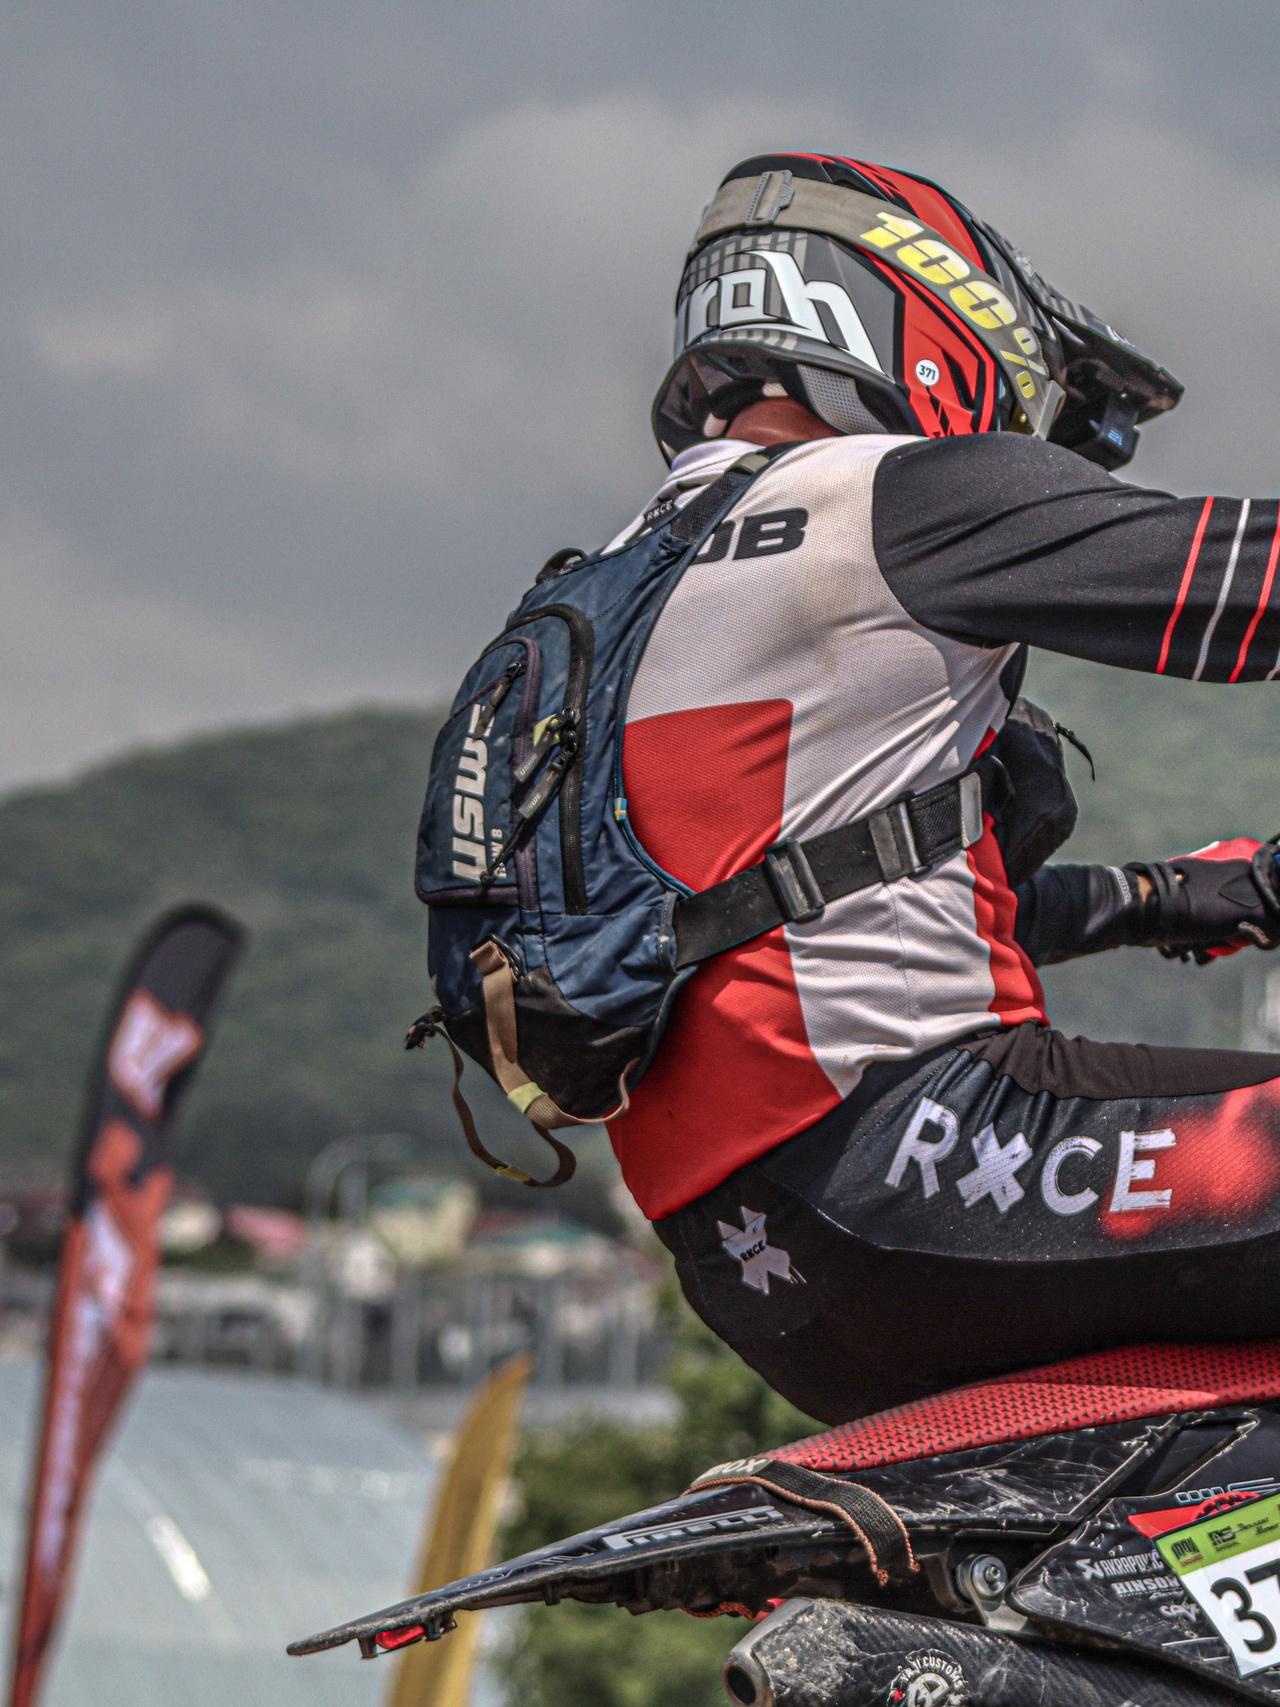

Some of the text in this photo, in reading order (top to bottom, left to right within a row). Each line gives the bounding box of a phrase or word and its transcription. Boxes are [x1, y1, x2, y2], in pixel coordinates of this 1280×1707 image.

[678, 249, 886, 376] roh
[861, 211, 1048, 399] 100%
[919, 364, 936, 381] 371
[602, 1505, 784, 1550] PIRELLI
[921, 1656, 965, 1689] CUSTOMS
